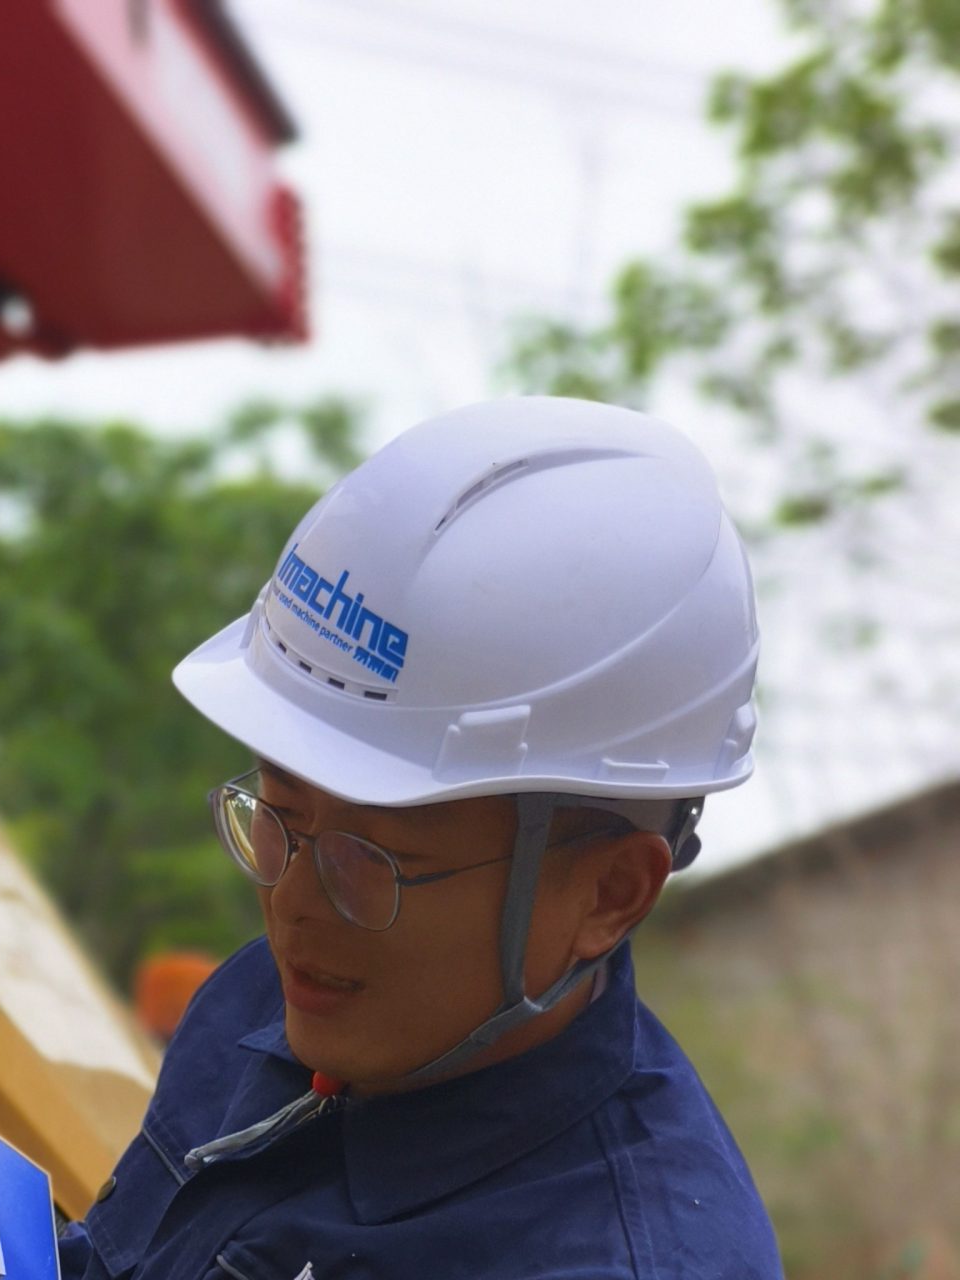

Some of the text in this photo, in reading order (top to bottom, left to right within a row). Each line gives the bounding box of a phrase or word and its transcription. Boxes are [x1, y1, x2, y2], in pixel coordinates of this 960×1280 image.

[277, 543, 409, 668] imachine
[291, 603, 320, 632] machine
[319, 626, 354, 653] partner
